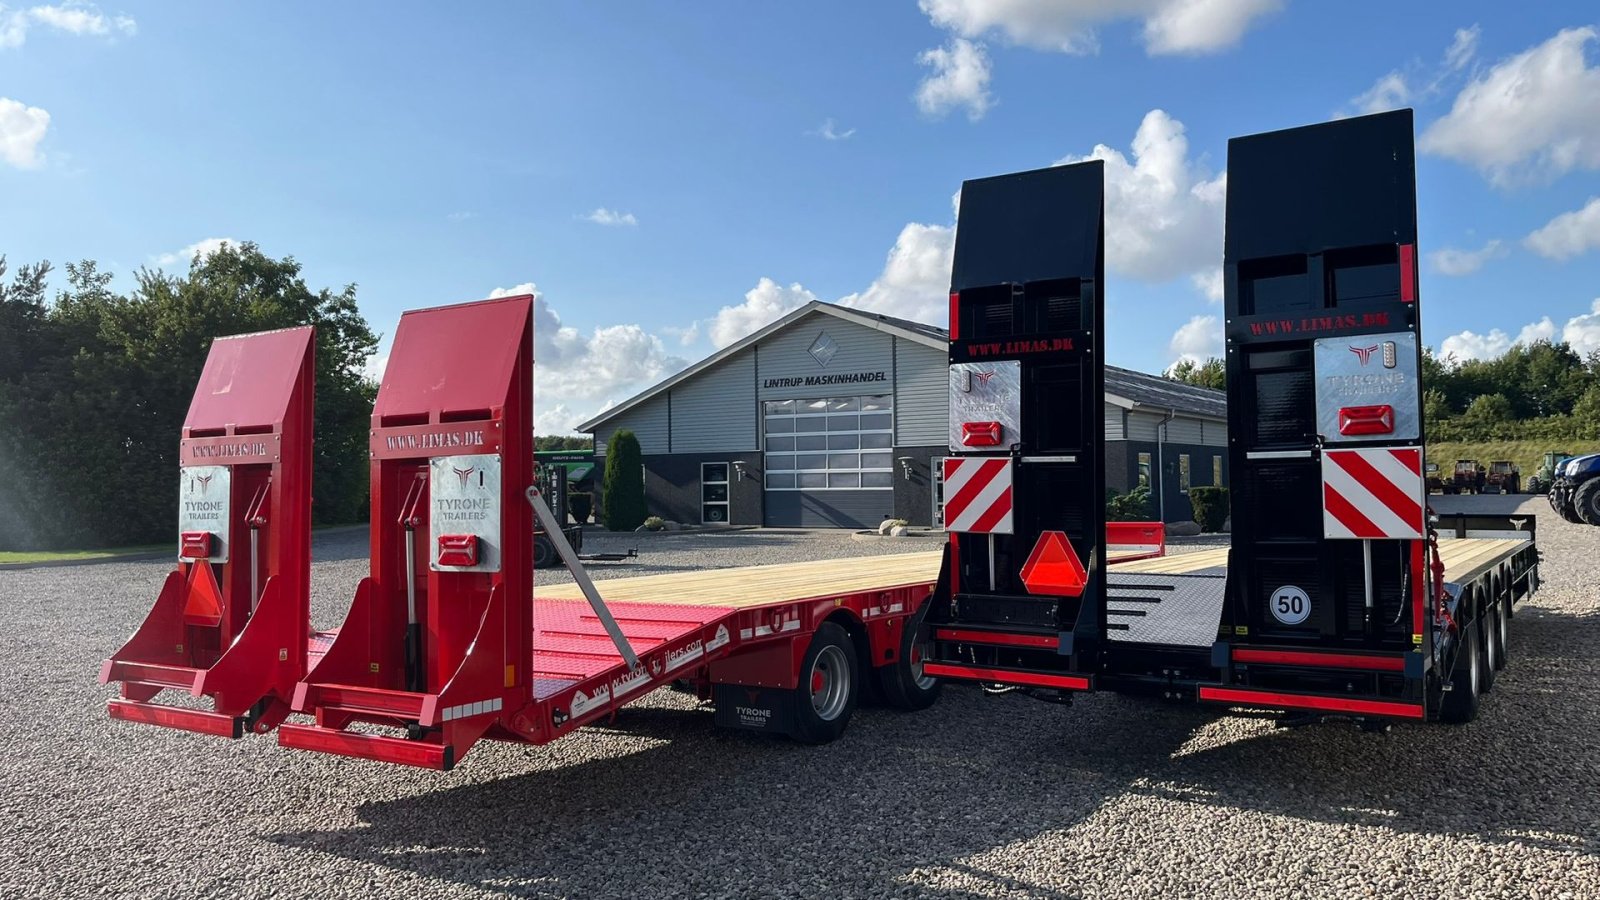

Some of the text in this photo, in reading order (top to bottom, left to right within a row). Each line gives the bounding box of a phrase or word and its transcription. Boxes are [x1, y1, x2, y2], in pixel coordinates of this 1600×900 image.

[1250, 312, 1389, 335] WWW.LIMAS.DK
[968, 338, 1073, 356] WWW.LIMAS.DK
[763, 372, 887, 388] LINTRUP MASKINHANDEL
[1326, 373, 1404, 386] TYRONE
[387, 431, 484, 450] WWW.LIMAS.DK
[193, 443, 266, 457] WWW.LIMAS.DK
[185, 501, 223, 511] TYRONE
[437, 498, 491, 511] TYRONE
[188, 512, 220, 520] TRAILERS
[442, 511, 487, 521] TRAILERS
[1277, 595, 1303, 615] 50
[735, 706, 772, 718] TYRONE
[740, 714, 767, 722] TRAILERS
